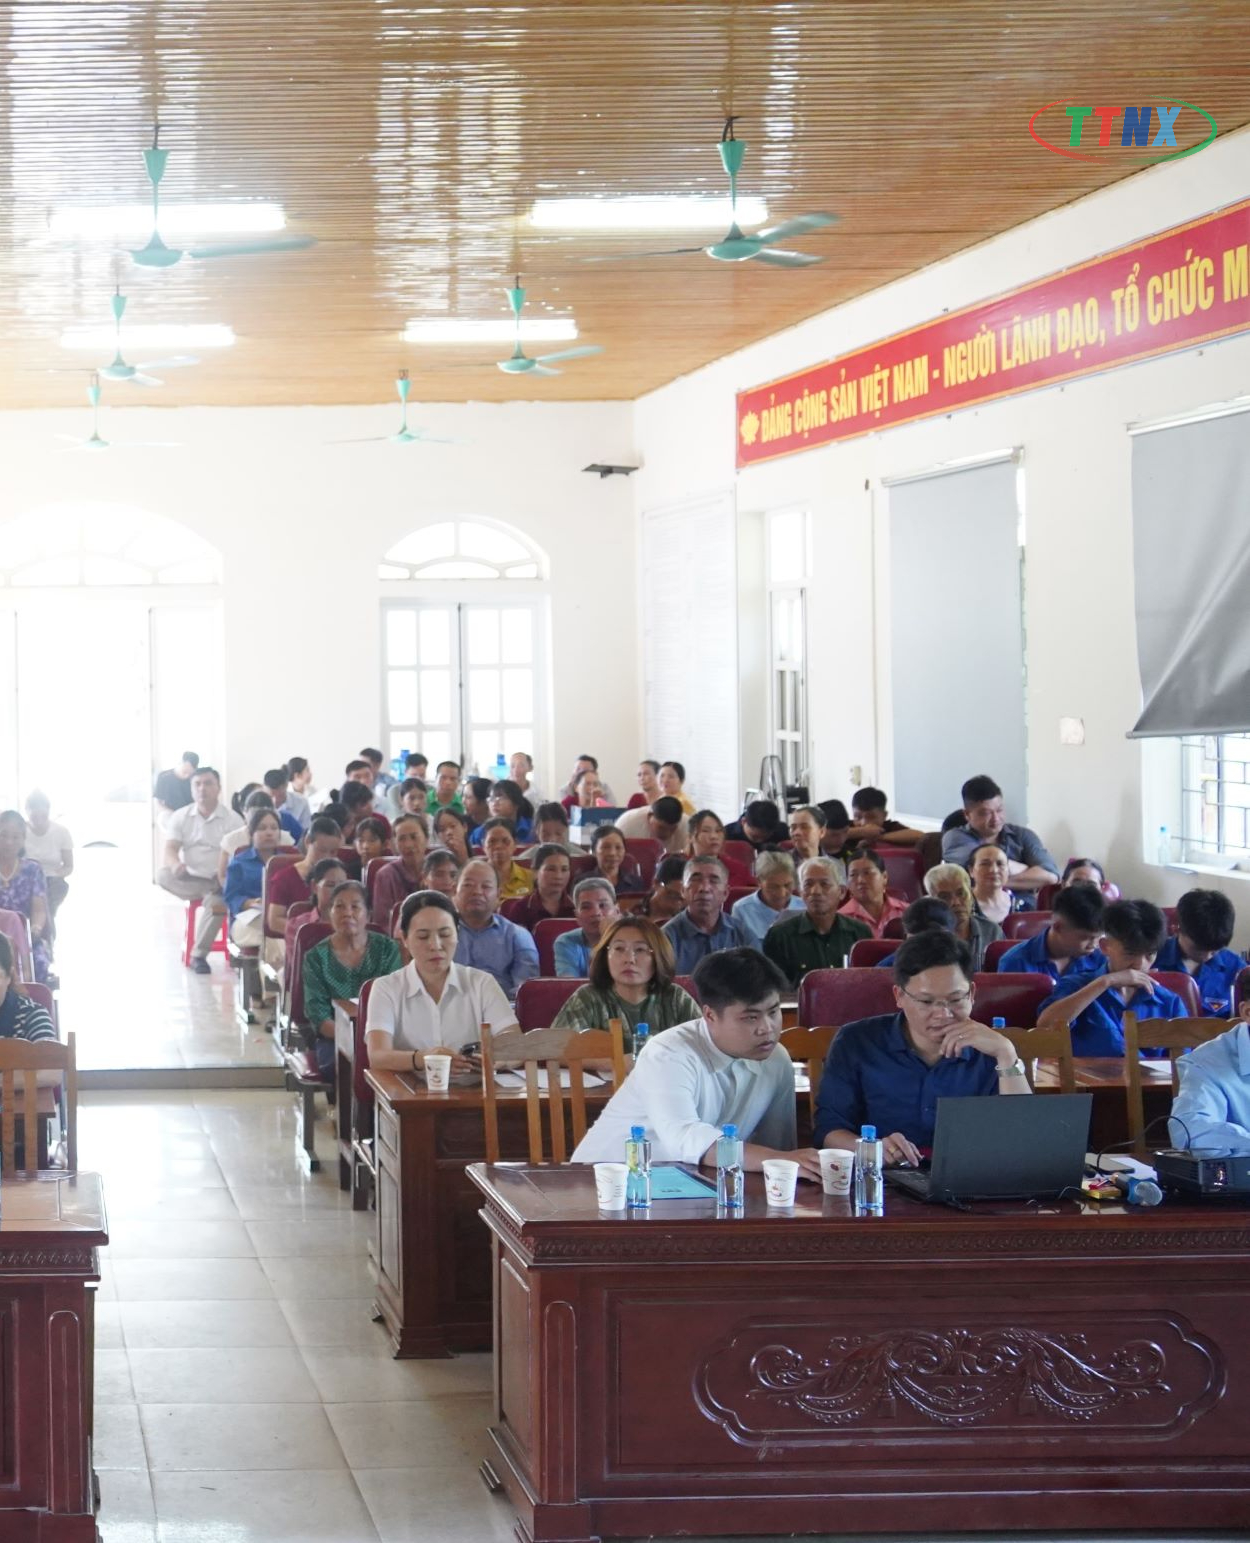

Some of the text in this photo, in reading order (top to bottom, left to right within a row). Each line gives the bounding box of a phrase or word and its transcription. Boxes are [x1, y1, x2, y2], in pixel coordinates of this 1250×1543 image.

[761, 392, 793, 443] ĐẢNG
[794, 388, 828, 439] CỘNG
[830, 367, 858, 423] SẢN
[860, 363, 890, 418] VIỆT
[892, 354, 929, 404] NAM
[943, 323, 997, 388] NGƯỜI
[1001, 314, 1052, 371] LÃNH
[1056, 297, 1106, 360] ĐẠO,
[1111, 262, 1141, 336] TỔ
[1147, 248, 1215, 326] CHỨC
